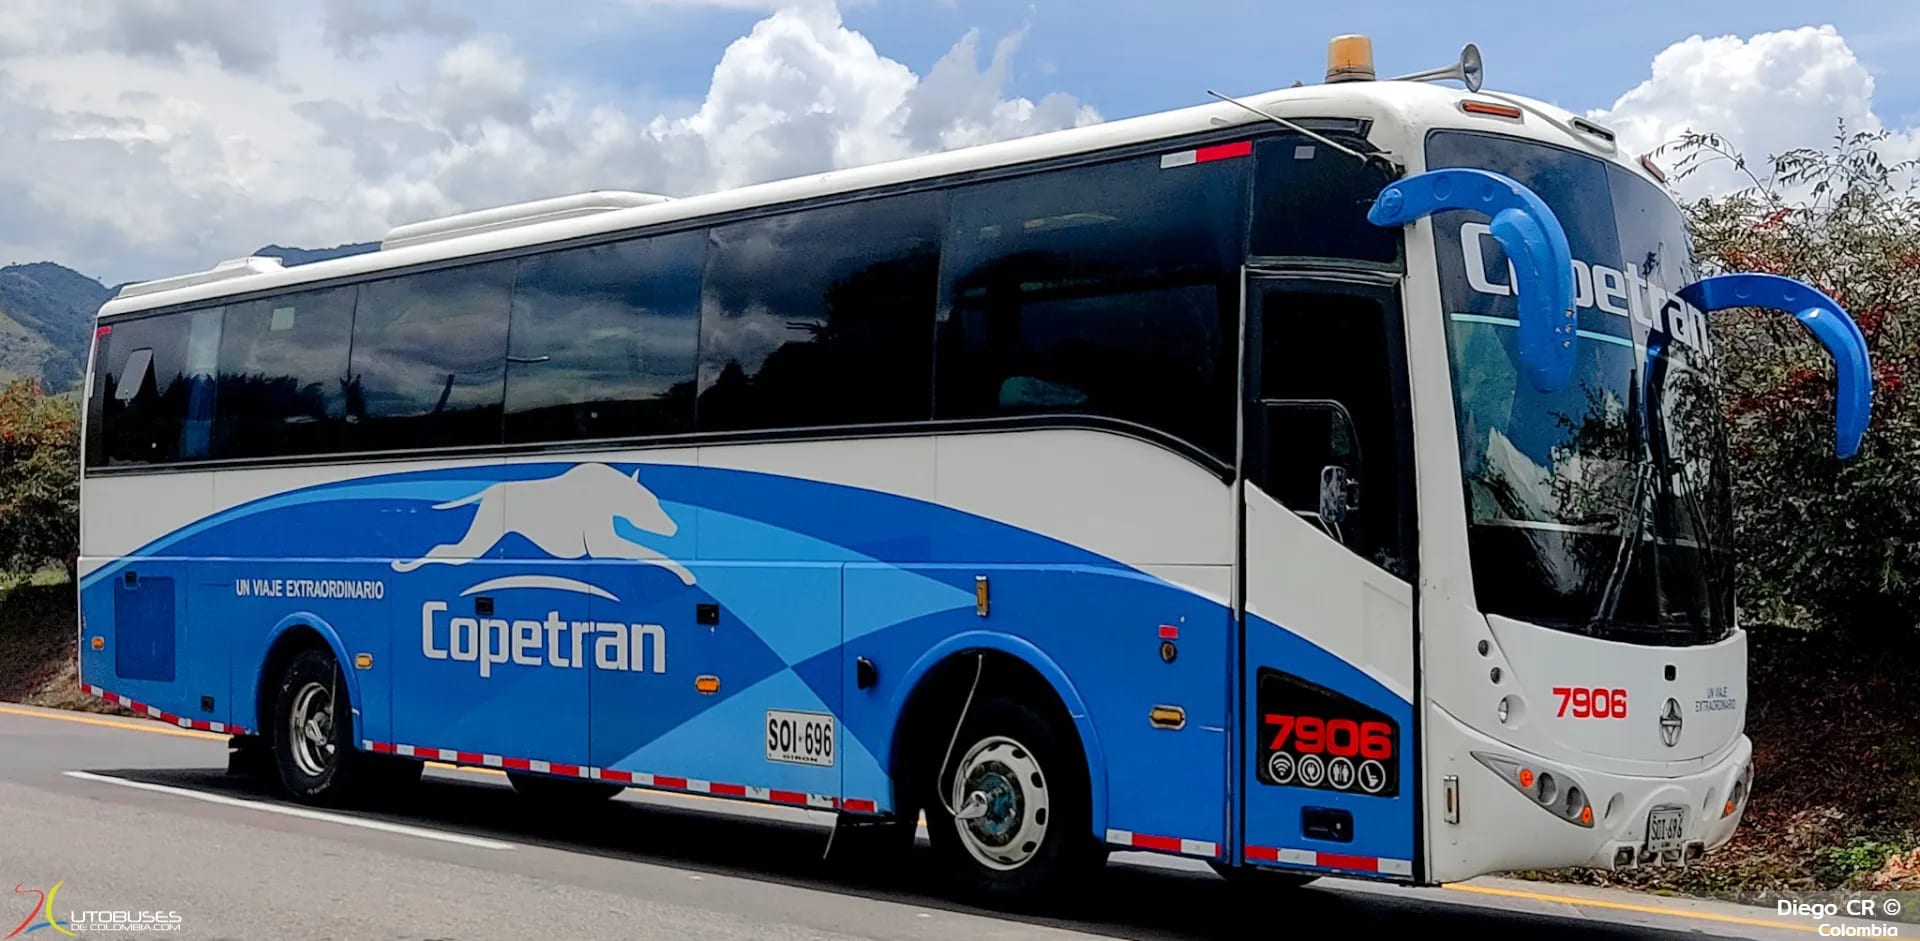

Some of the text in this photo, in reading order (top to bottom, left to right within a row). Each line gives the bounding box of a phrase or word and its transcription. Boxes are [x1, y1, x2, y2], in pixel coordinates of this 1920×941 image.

[236, 579, 384, 599] UN VIAJE EXTRAORDINARIO
[422, 601, 666, 678] Copetran
[1552, 687, 1628, 719] 7906
[1264, 713, 1392, 760] 7906
